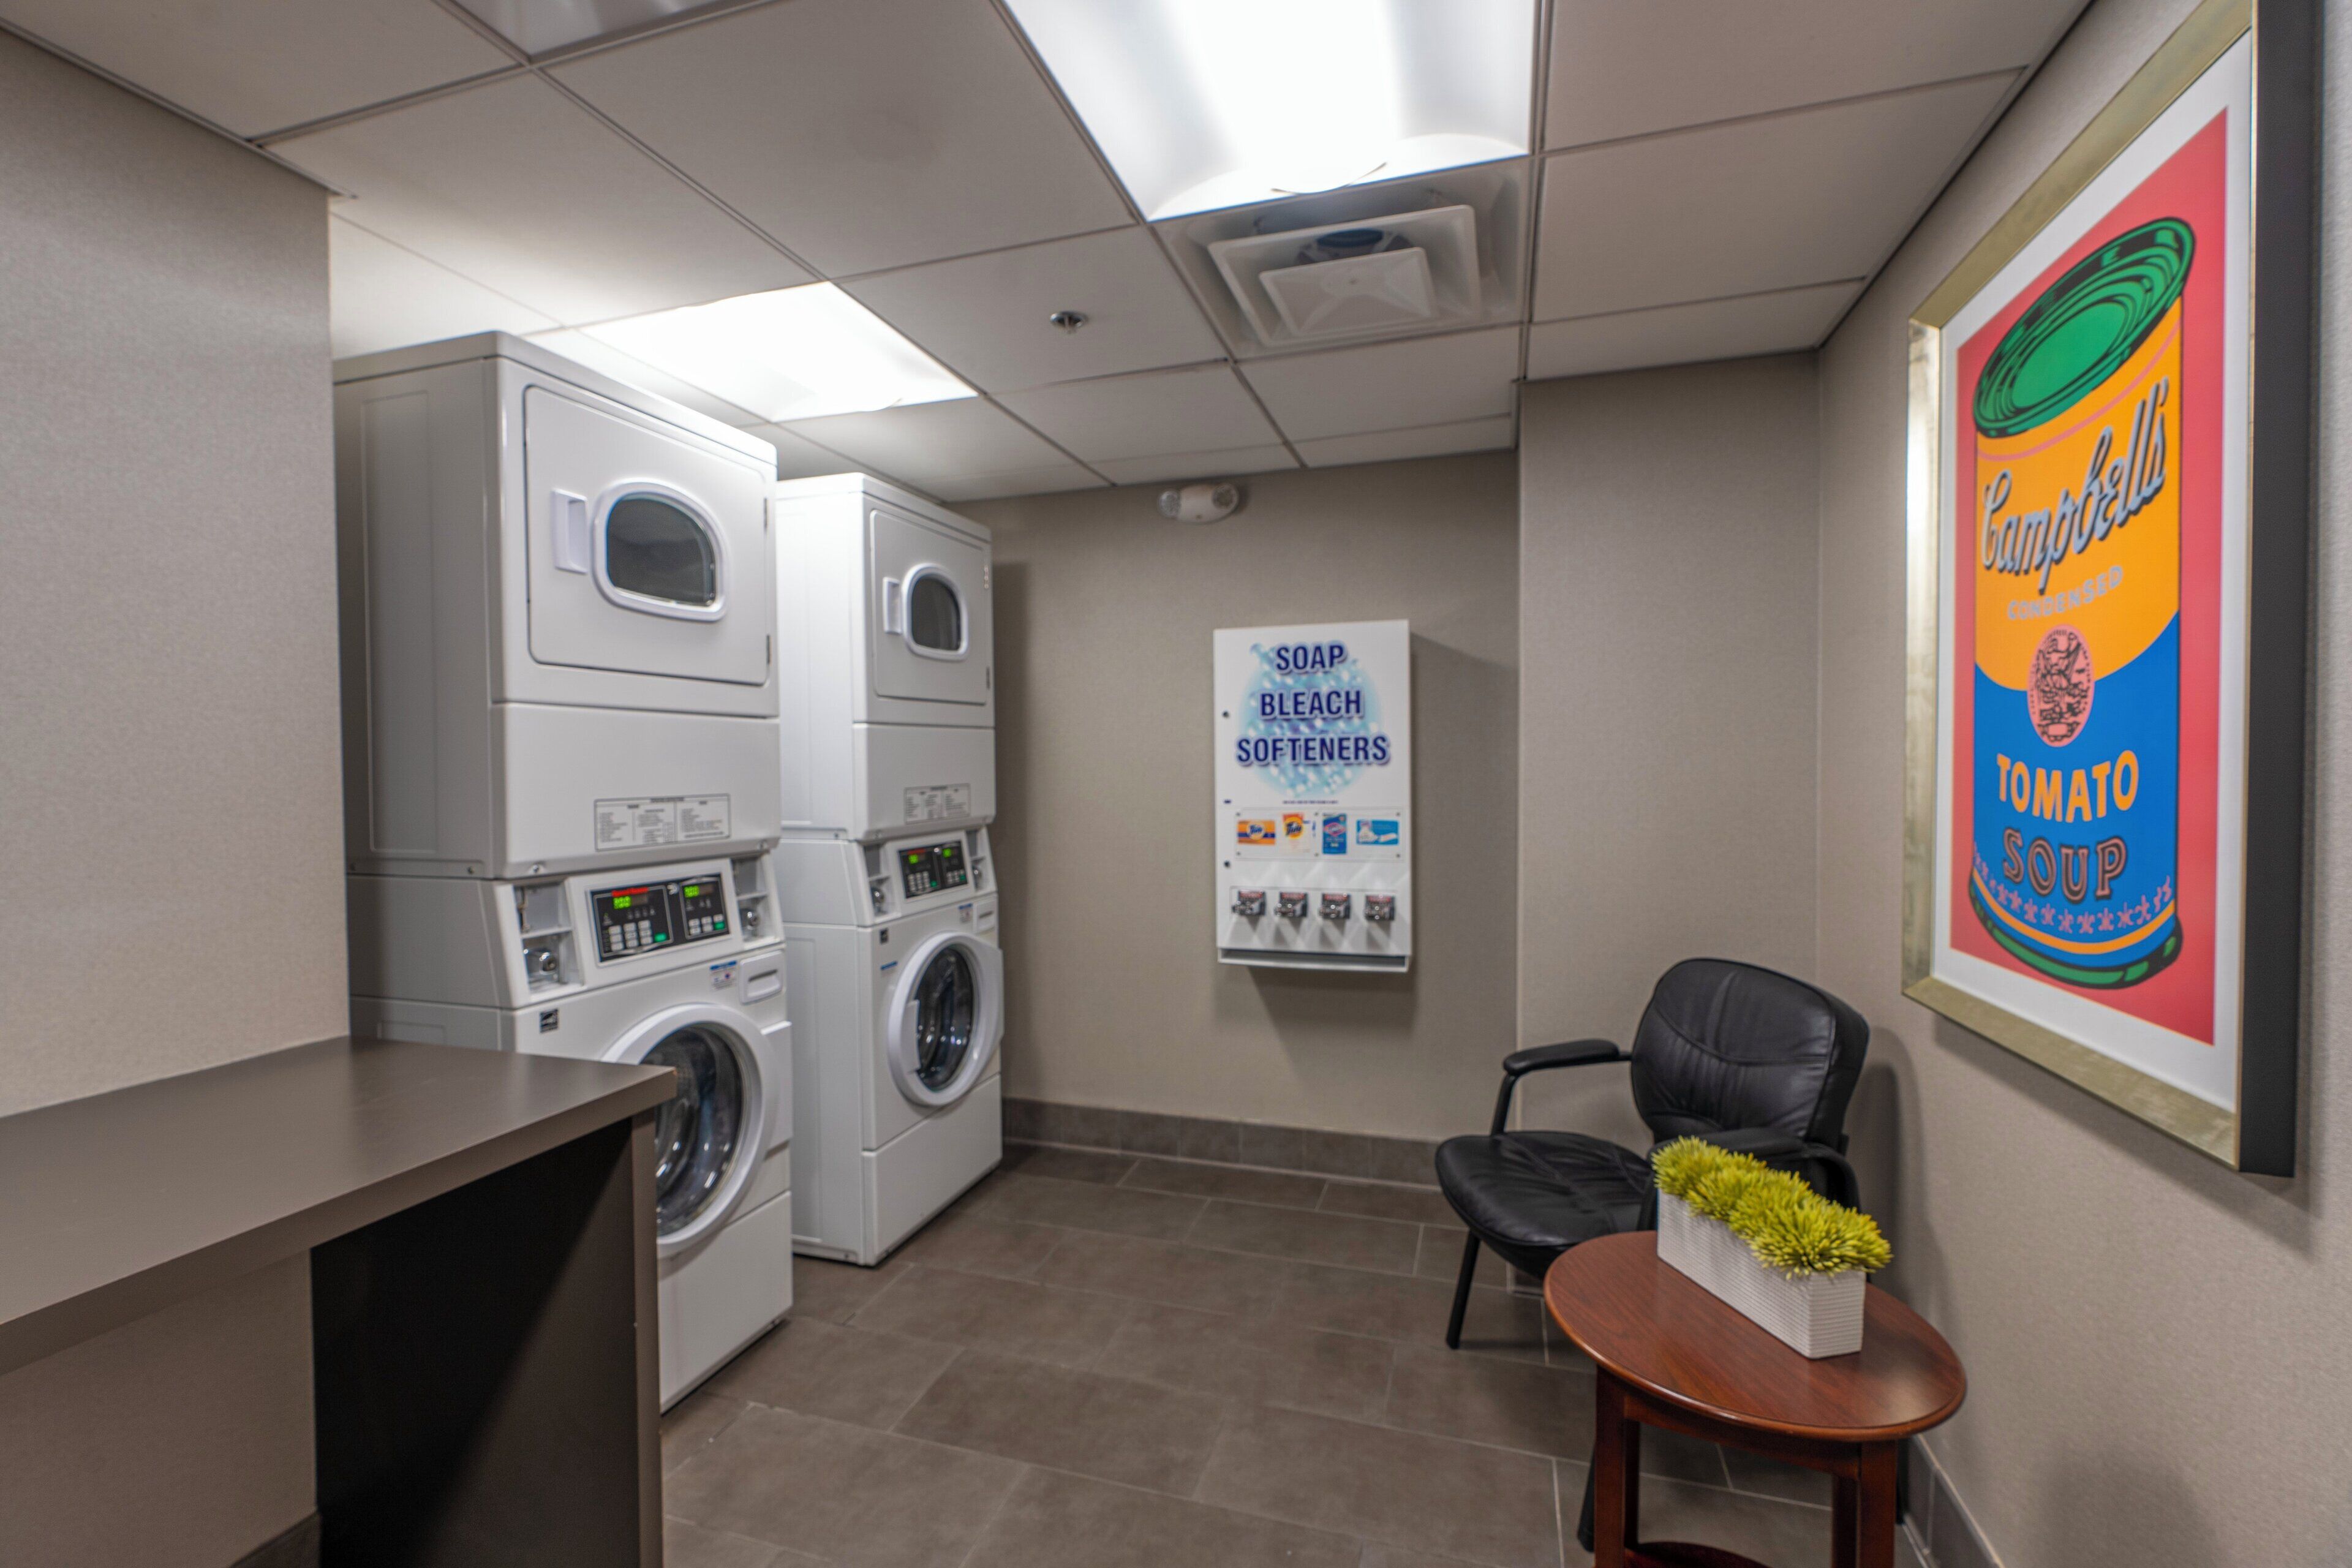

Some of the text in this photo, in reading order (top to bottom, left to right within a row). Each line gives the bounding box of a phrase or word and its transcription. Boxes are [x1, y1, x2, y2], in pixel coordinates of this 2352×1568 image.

[1981, 375, 2169, 595] Campbell's
[2007, 565, 2124, 620] CONDENSED
[1276, 644, 1346, 671] SOAP
[1260, 690, 1362, 717] BLEACH
[1237, 736, 1388, 763] SOFTENERS
[1997, 750, 2139, 823] TOMATO
[2002, 826, 2128, 905] SOUP
